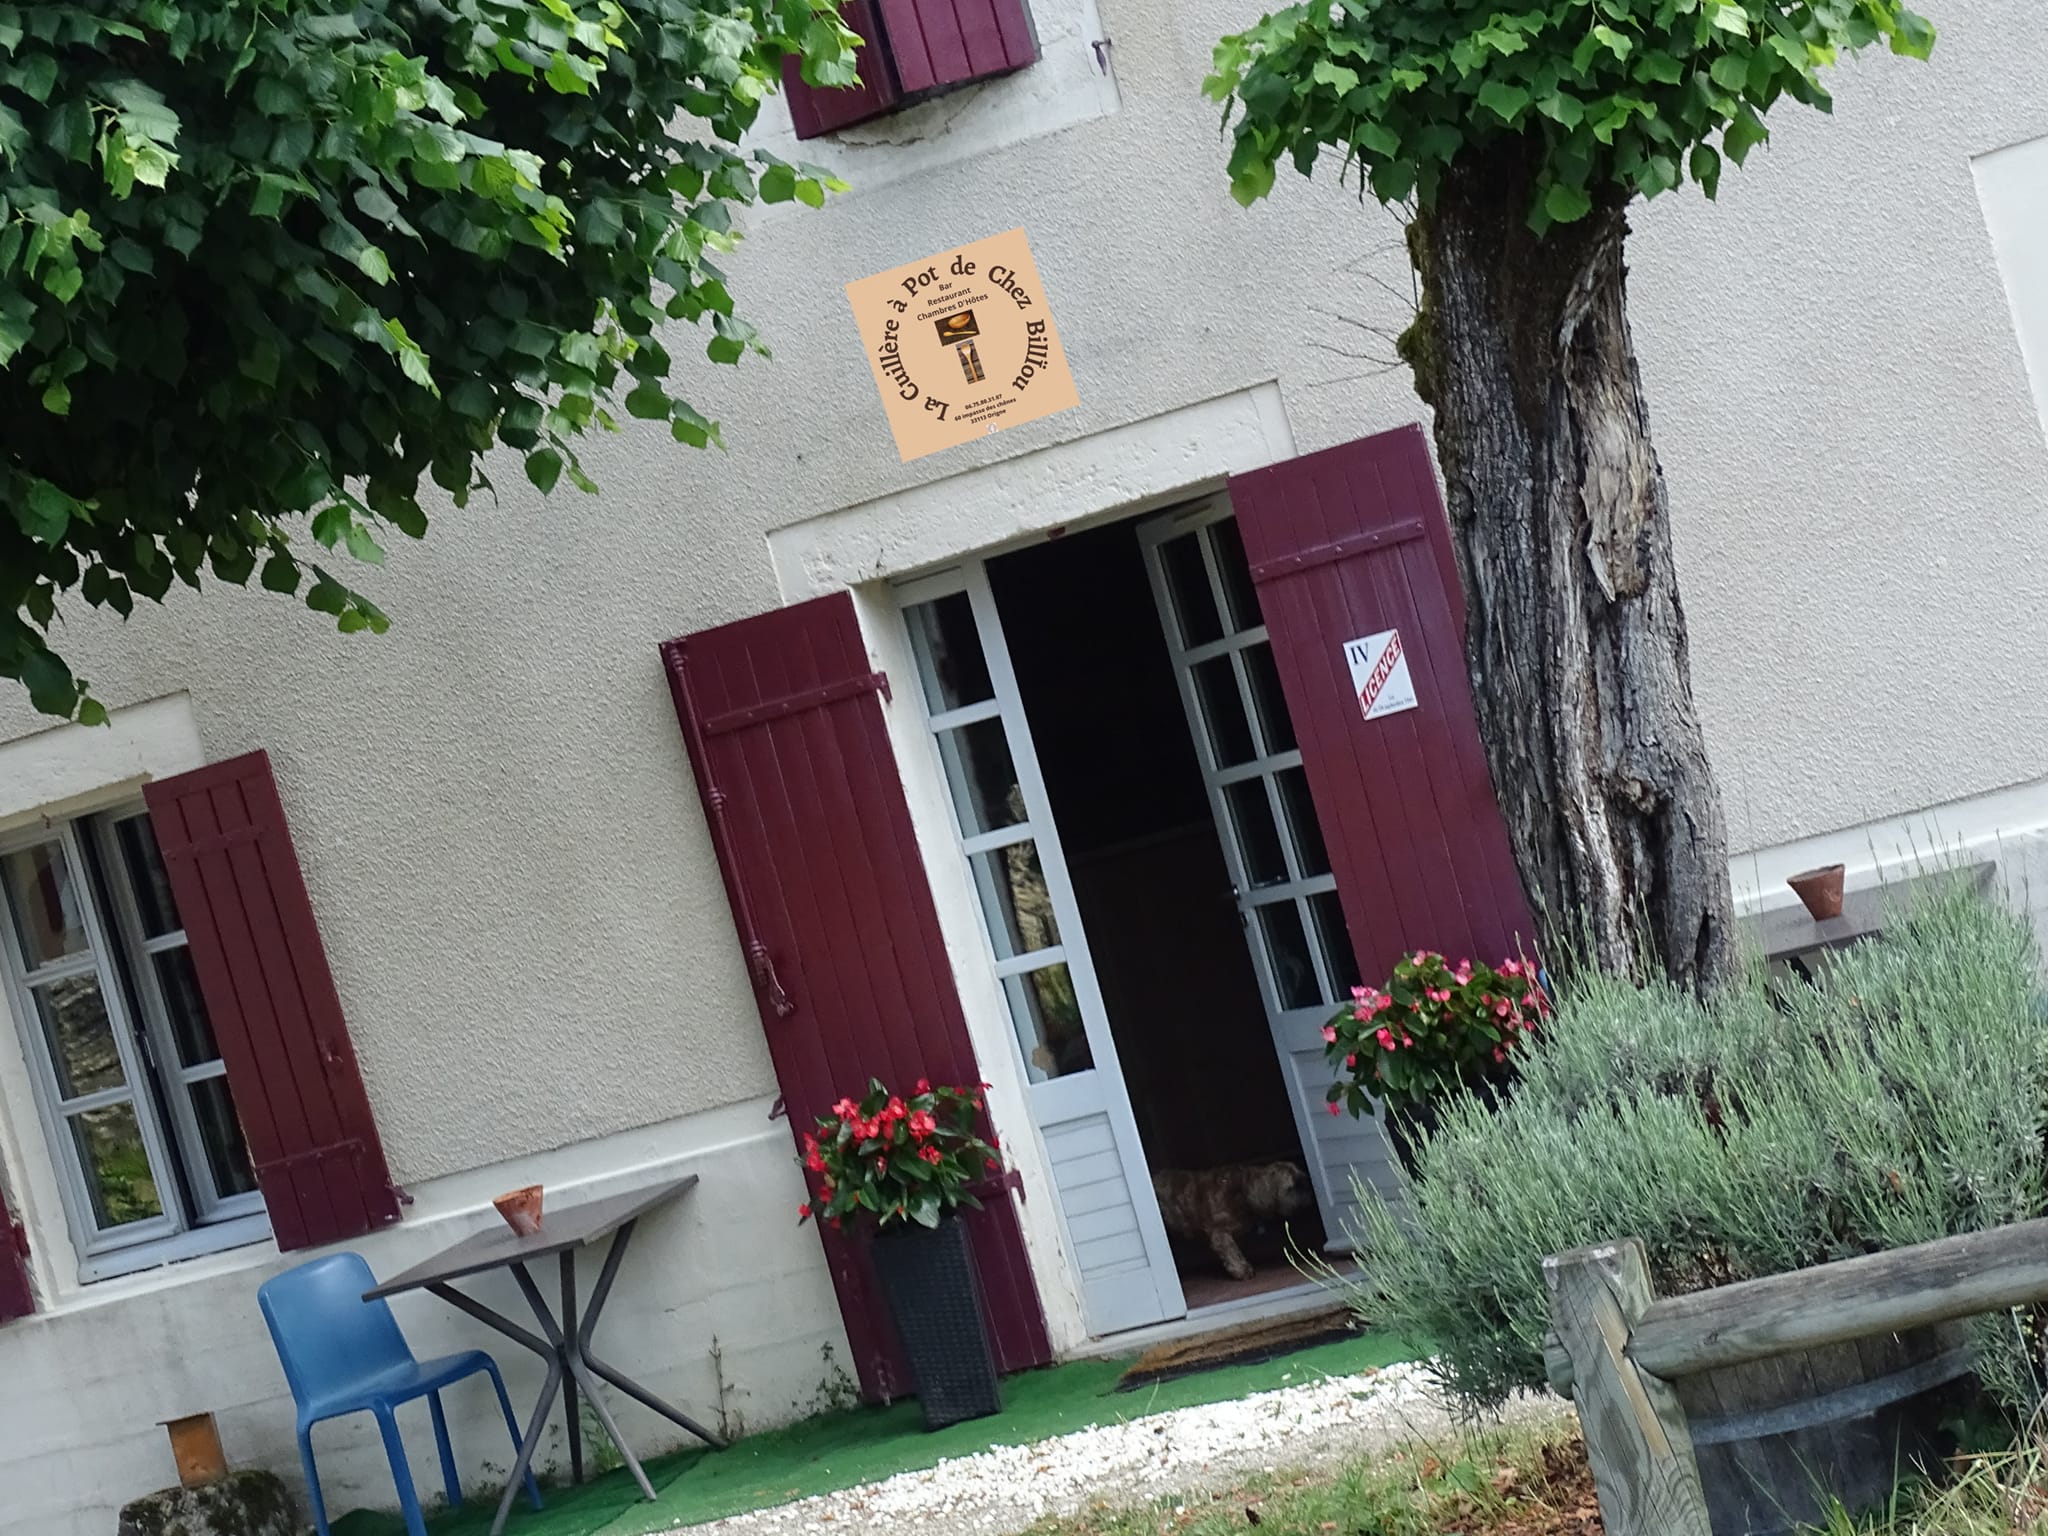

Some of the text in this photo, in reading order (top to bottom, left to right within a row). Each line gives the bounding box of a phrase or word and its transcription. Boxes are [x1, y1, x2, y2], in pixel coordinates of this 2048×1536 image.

[950, 254, 977, 276] de
[901, 266, 940, 299] Pot
[938, 282, 953, 292] Bar
[988, 265, 1033, 311] Chez
[886, 299, 909, 314] à
[917, 294, 989, 322] Chambres D'Hôtes
[927, 288, 972, 307] Restaurant
[878, 319, 920, 401] Cuillère
[924, 396, 951, 422] La
[962, 408, 986, 419] impasse
[986, 403, 998, 412] des
[997, 398, 1017, 409] chênes
[970, 409, 1006, 425] 33113 Origne
[1350, 642, 1369, 665] IV
[1361, 635, 1401, 711] LICENCE
